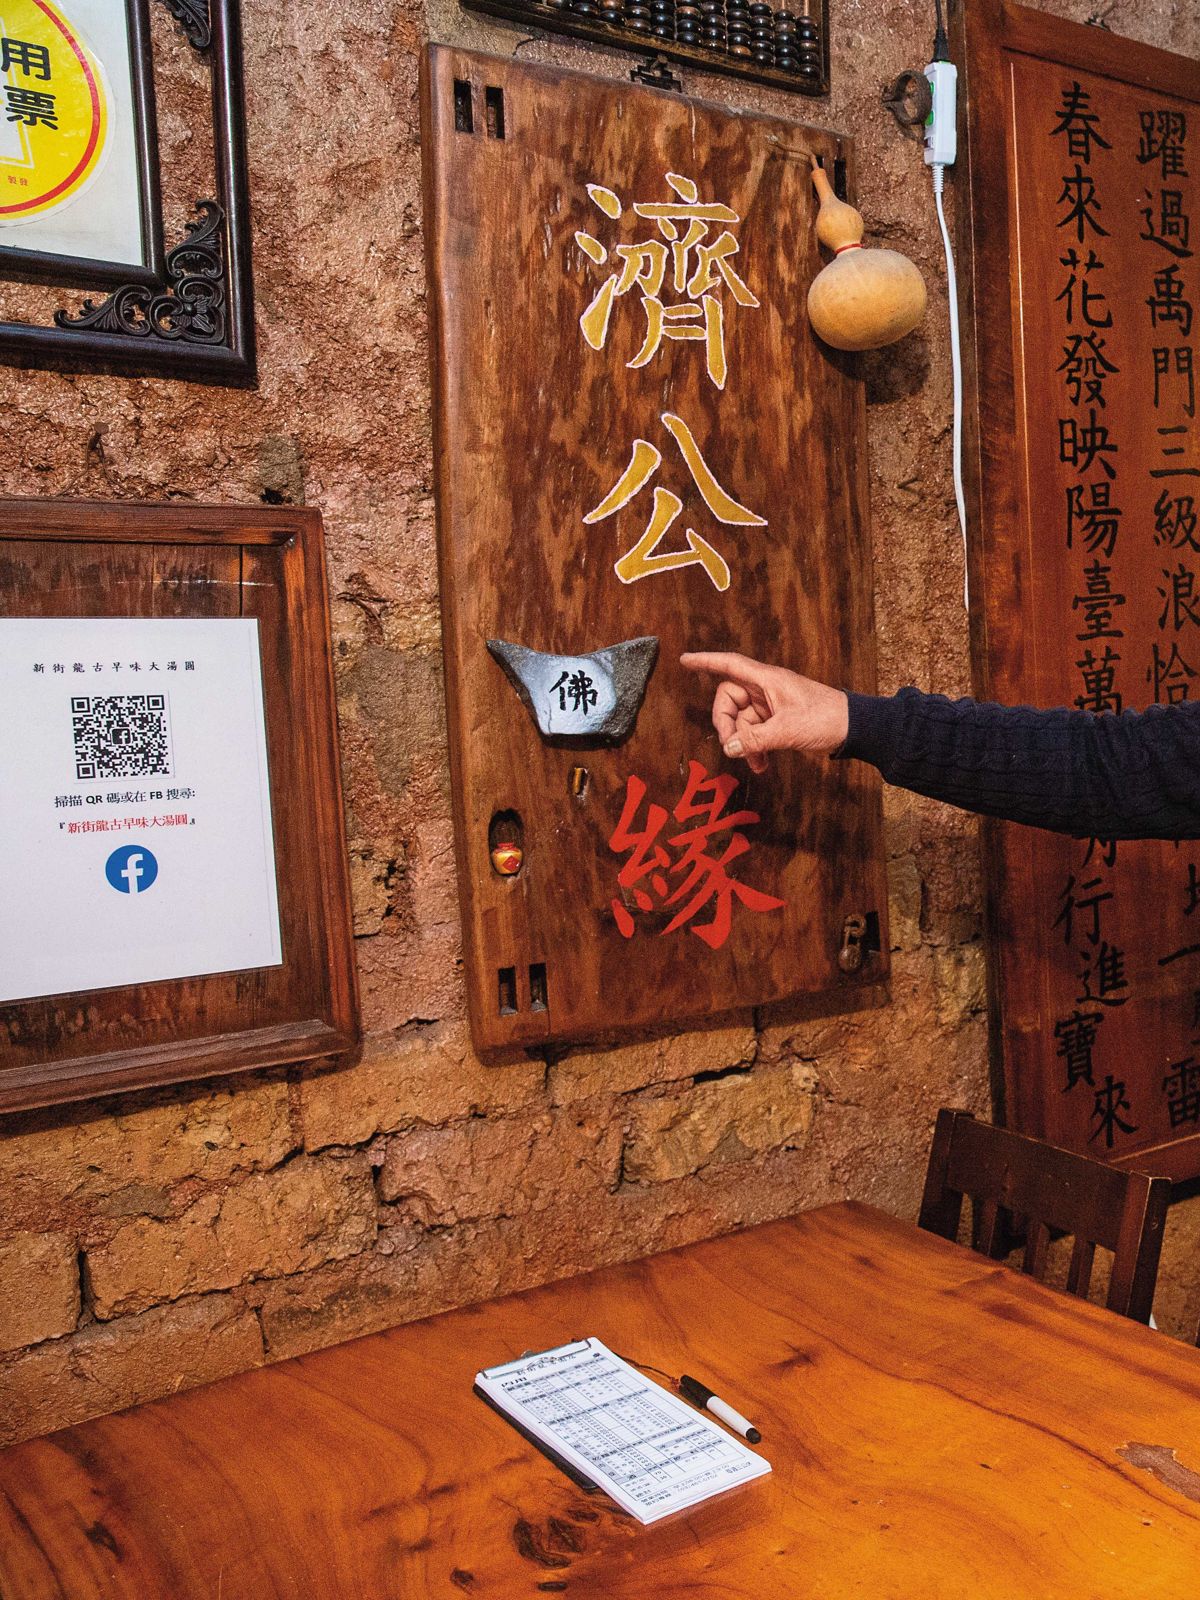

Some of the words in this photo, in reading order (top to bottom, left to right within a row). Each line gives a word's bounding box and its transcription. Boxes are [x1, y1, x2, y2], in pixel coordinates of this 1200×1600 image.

[575, 172, 768, 592] 濟公
[33, 660, 196, 674] 新街龍古早味大湯圓
[549, 670, 599, 717] 佛
[54, 795, 83, 808] 掃描
[86, 795, 104, 805] QR
[106, 790, 147, 805] 碼或在
[150, 791, 163, 801] FB
[609, 759, 786, 950] 緣
